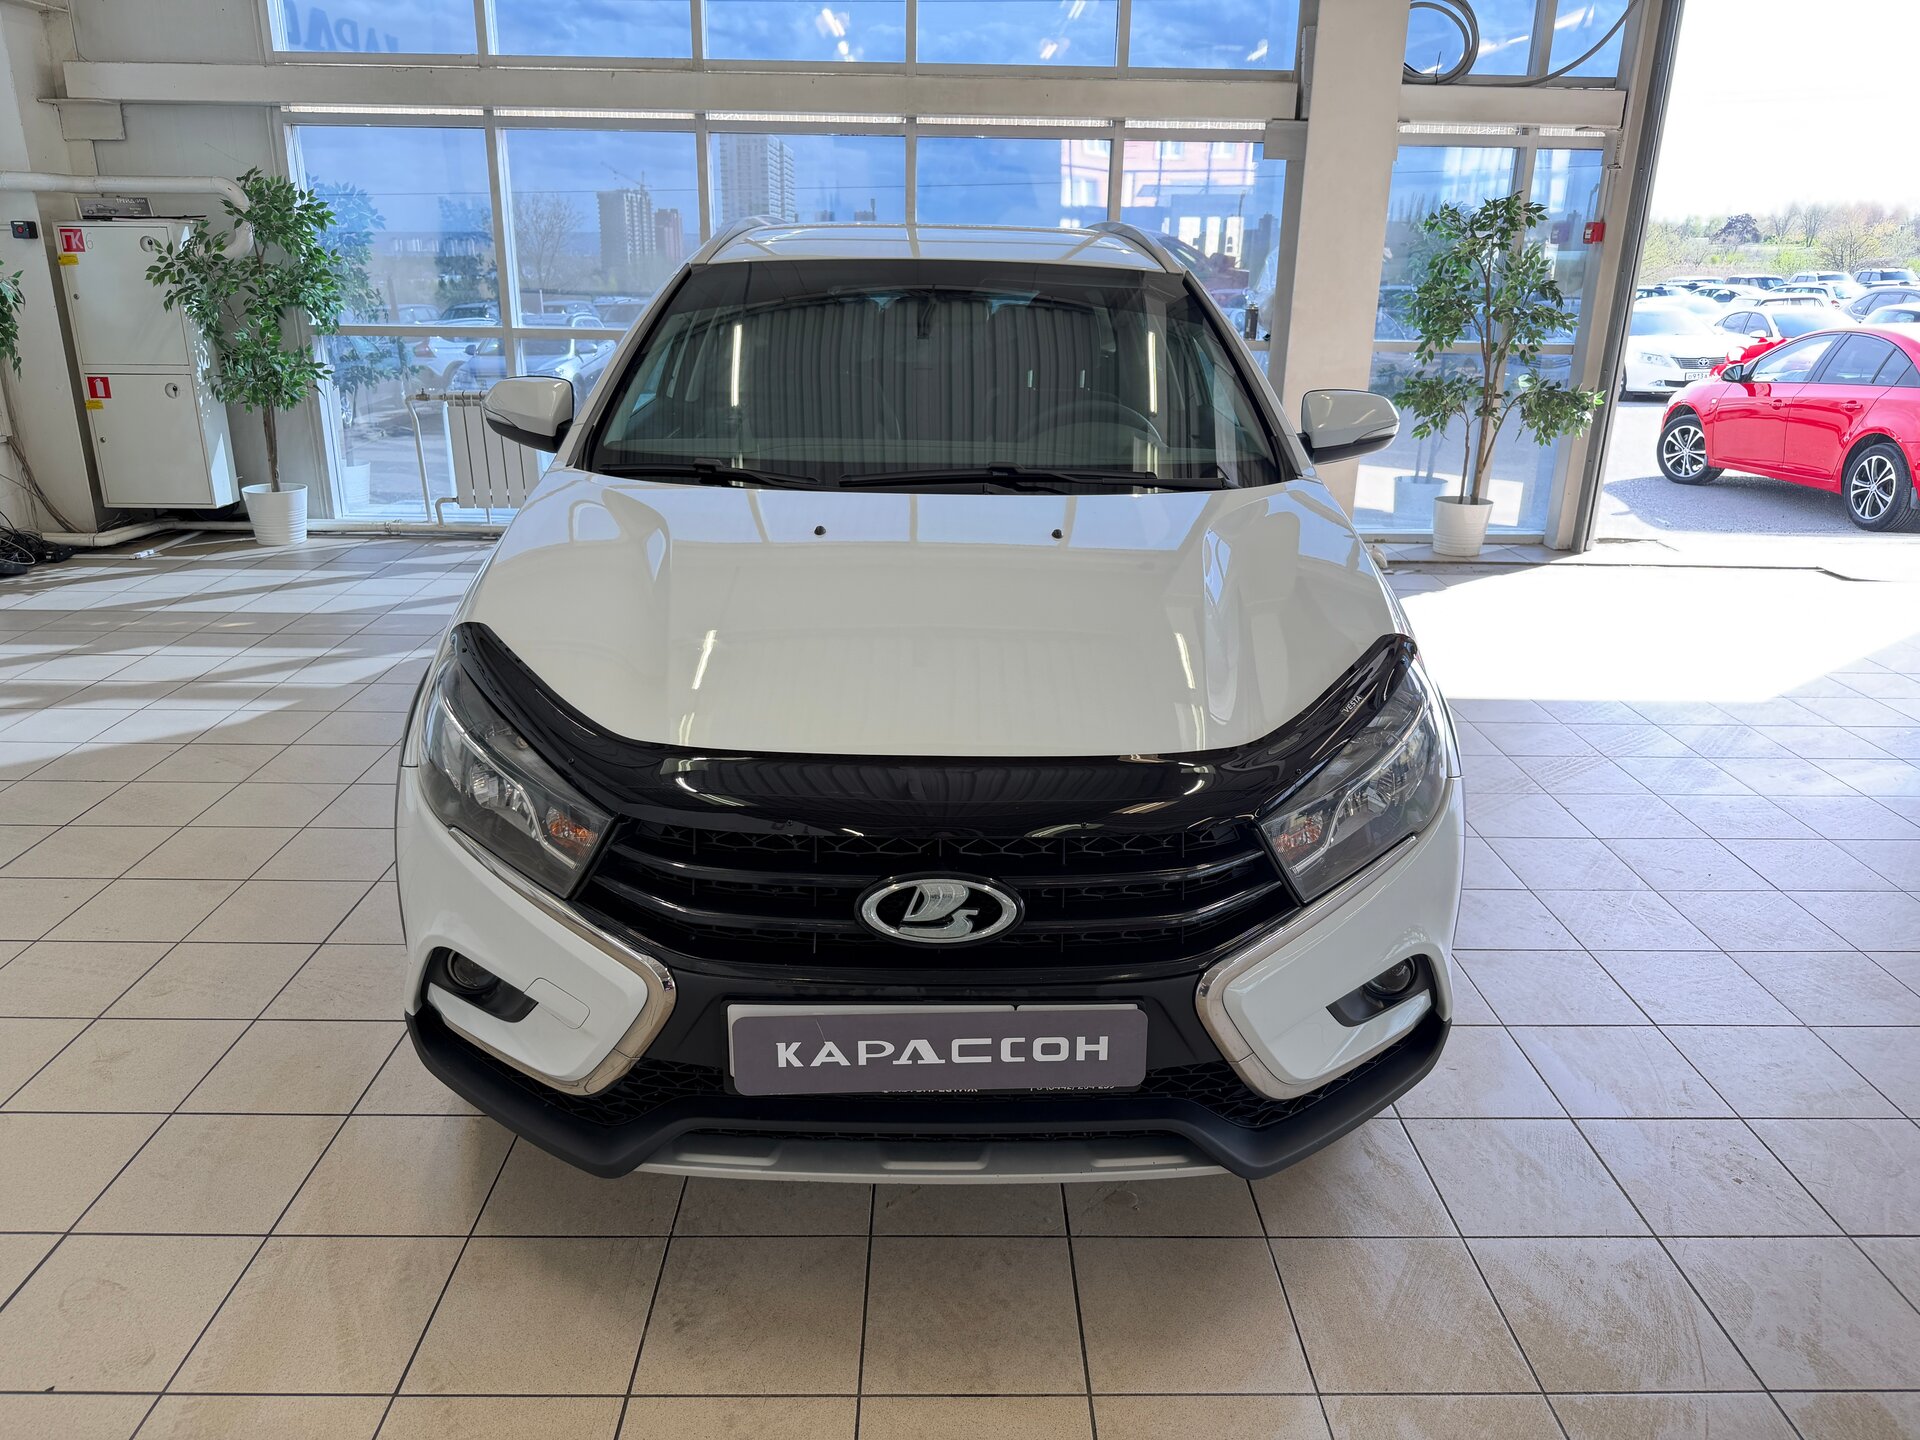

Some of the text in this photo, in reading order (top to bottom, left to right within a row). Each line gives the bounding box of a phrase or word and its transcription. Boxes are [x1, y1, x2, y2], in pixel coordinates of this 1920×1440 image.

[61, 231, 84, 250] ПК
[1342, 696, 1362, 712] VESTA
[776, 1036, 1109, 1068] КАРАССОН
